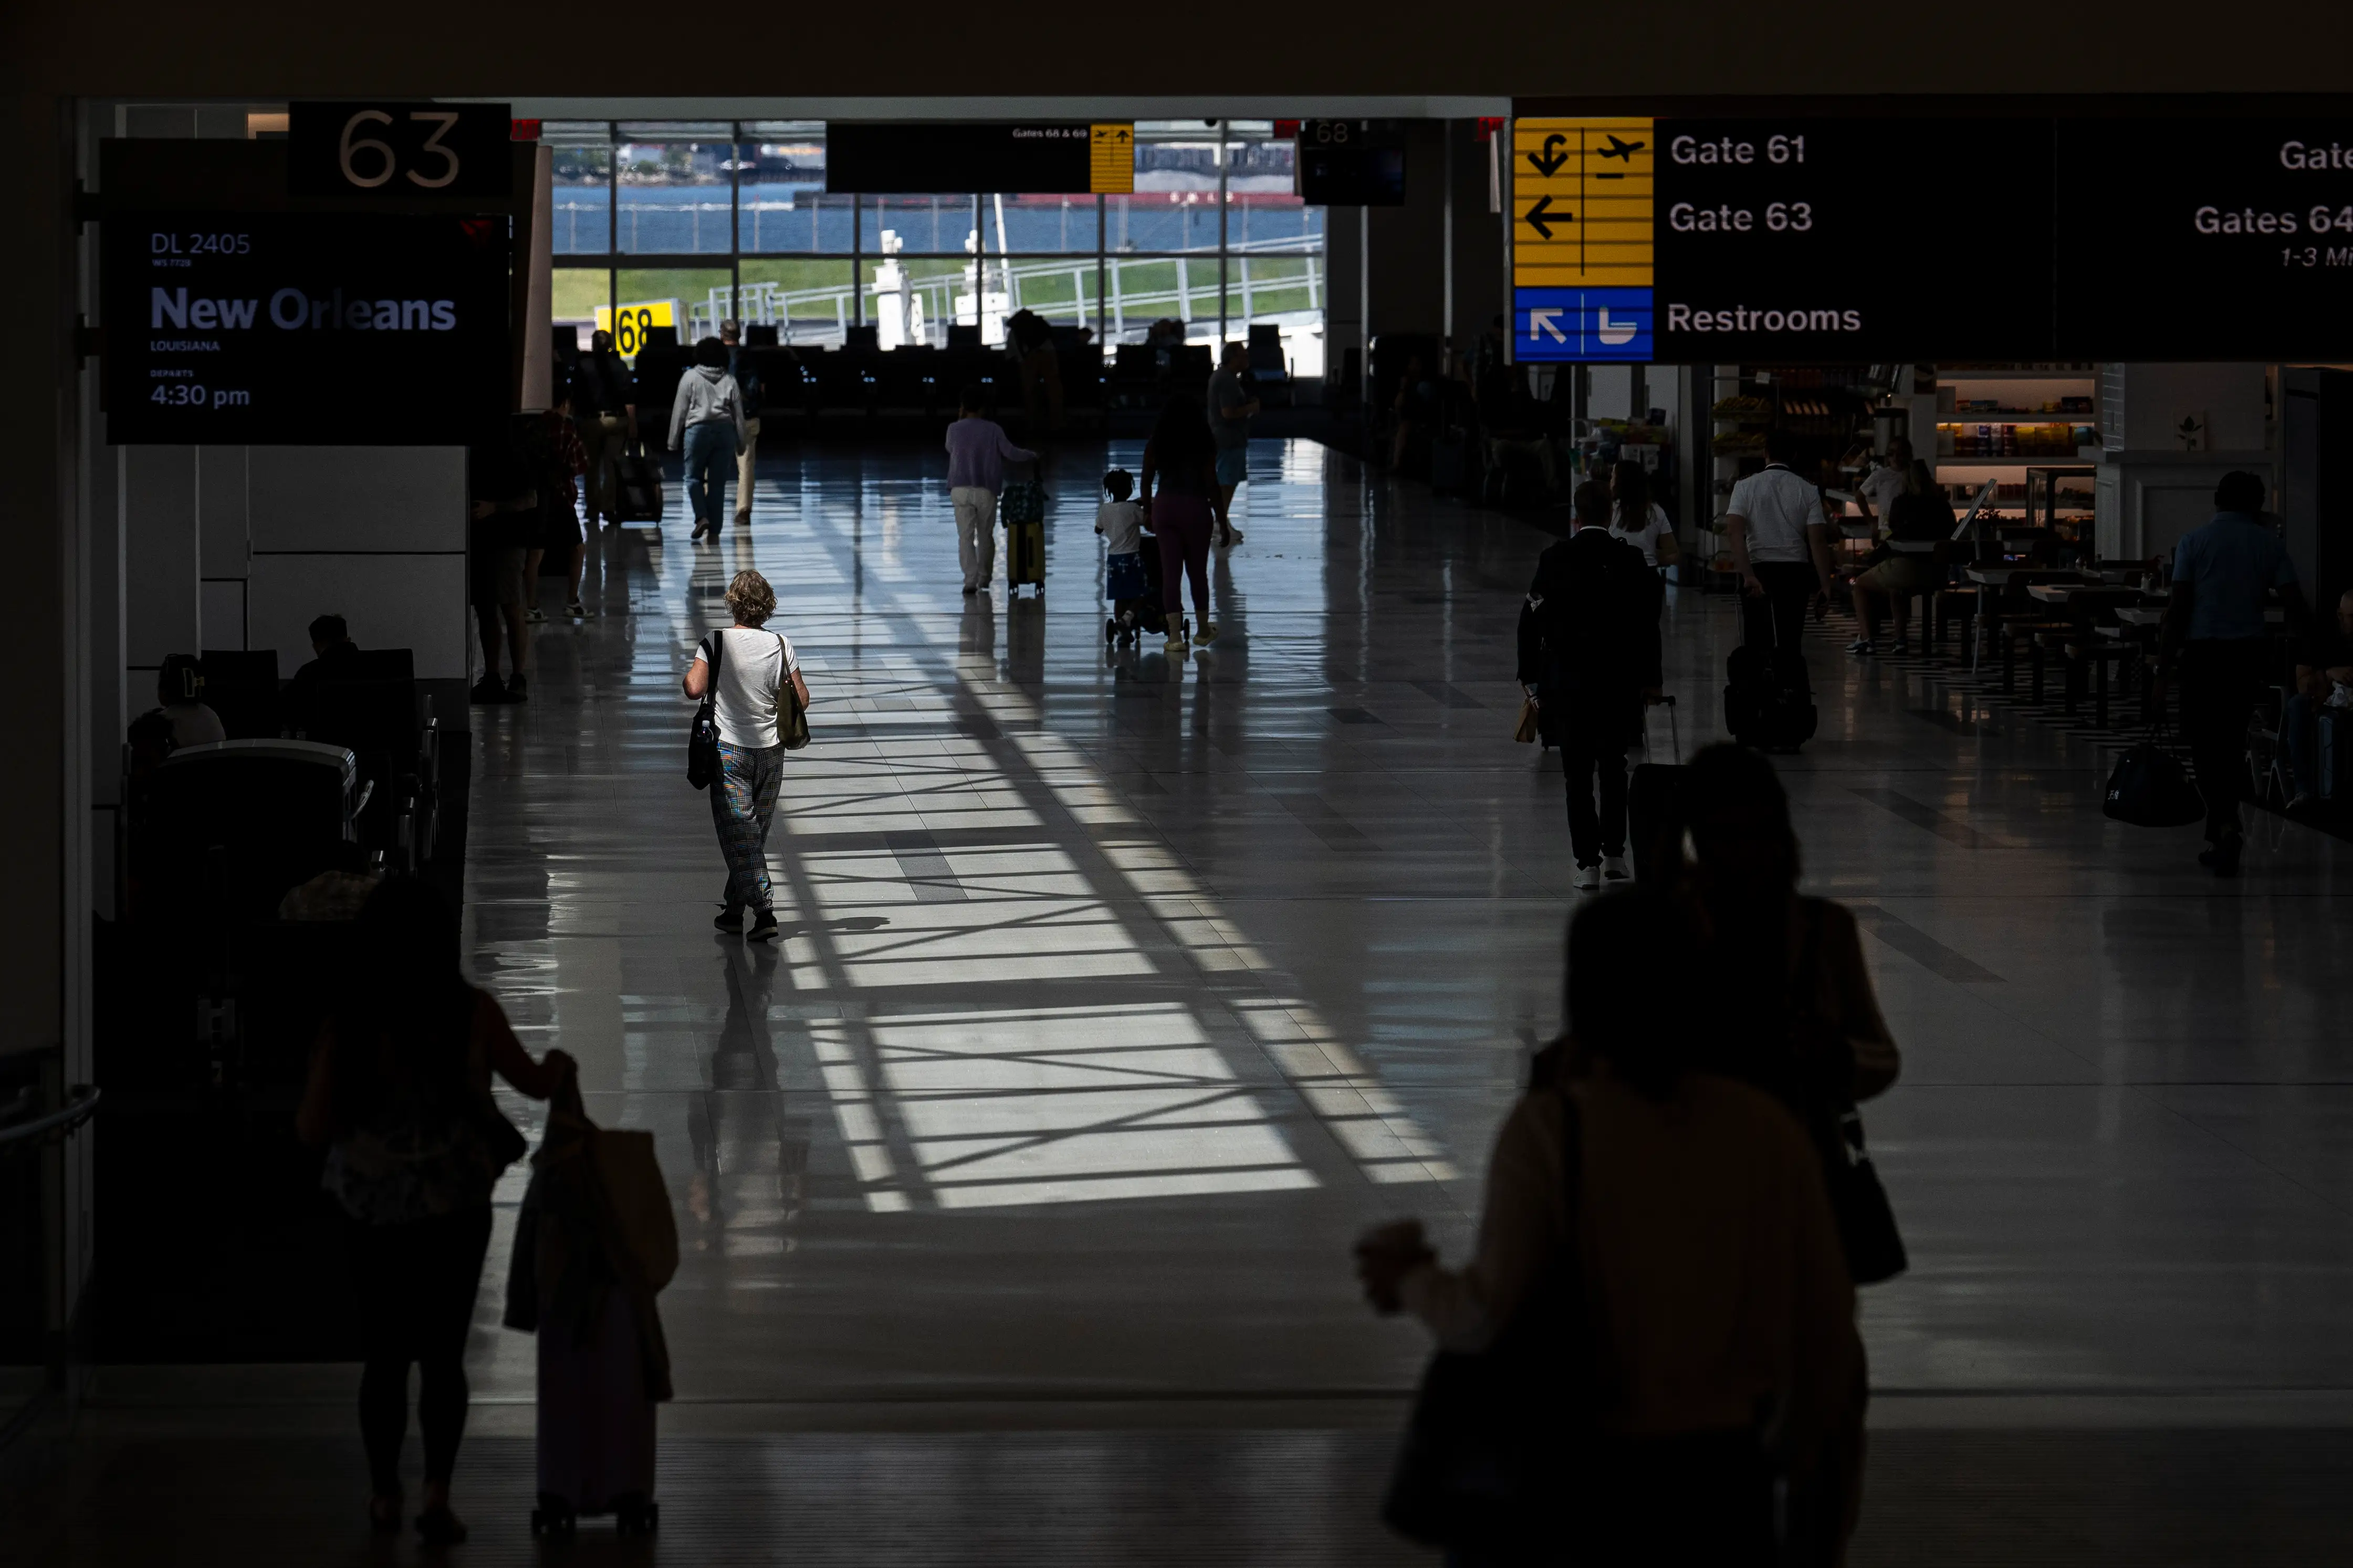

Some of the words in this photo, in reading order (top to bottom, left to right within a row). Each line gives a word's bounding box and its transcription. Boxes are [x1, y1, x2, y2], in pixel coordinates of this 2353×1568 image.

[1012, 128, 1044, 139] Gates
[1062, 129, 1070, 138] &
[1316, 122, 1348, 143] 68
[339, 109, 459, 188] 63
[1671, 134, 1754, 165] Gate
[1766, 134, 1806, 164] 61
[2279, 140, 2353, 170] Gate
[1669, 202, 1753, 232] Gate
[1765, 201, 1813, 232] 63
[2194, 205, 2298, 234] Gates
[2308, 205, 2353, 234] 64
[151, 233, 184, 254] DL
[189, 233, 250, 255] 2405
[2281, 246, 2317, 268] 1-3
[150, 287, 259, 330] New
[269, 287, 456, 331] Orleans
[1667, 303, 1862, 332] Restrooms
[619, 309, 652, 353] 68
[150, 340, 221, 352] LOUISIANA
[150, 369, 194, 378] DEPARTS
[150, 384, 207, 406] 4:30
[213, 390, 250, 411] pm
